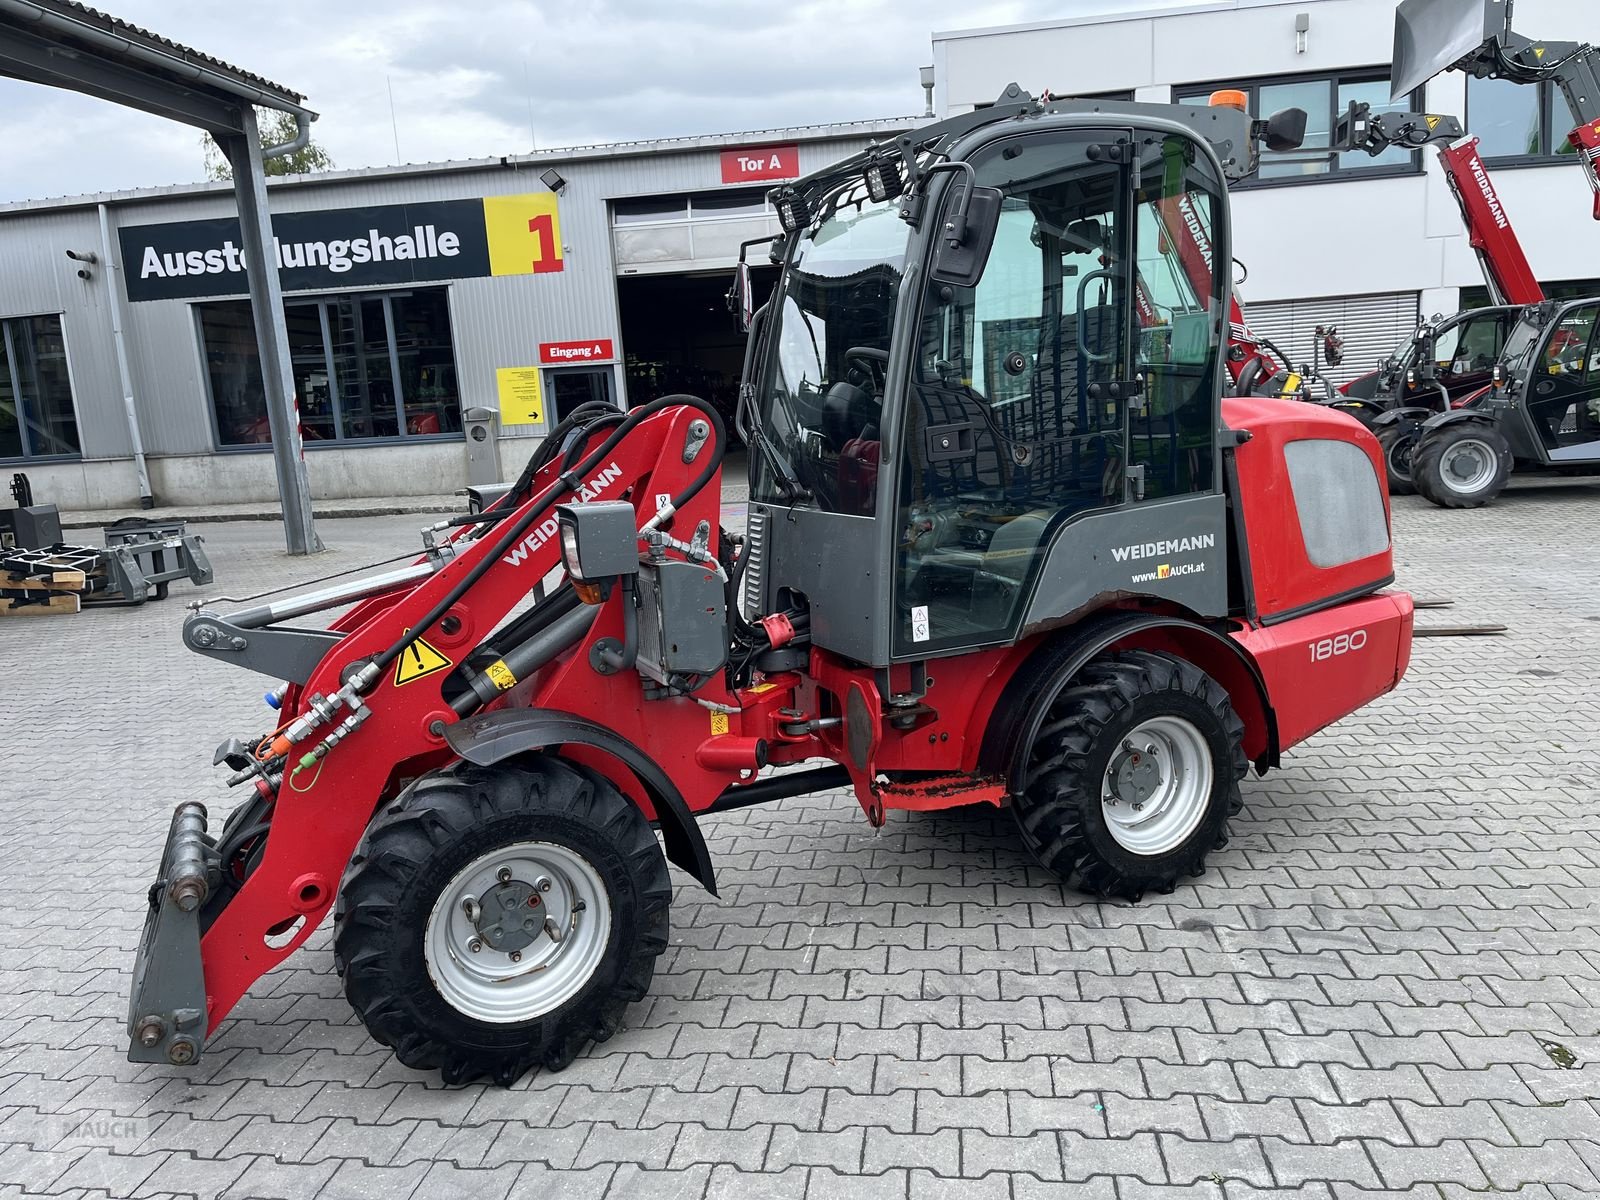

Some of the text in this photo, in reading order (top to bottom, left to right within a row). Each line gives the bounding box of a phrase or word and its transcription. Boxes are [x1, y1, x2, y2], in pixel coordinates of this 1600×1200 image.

[737, 154, 782, 172] Tor A
[1469, 156, 1508, 230] WEIDEMANN
[140, 214, 564, 279] Ausstlungshalle 1
[1178, 196, 1213, 275] WEIDEMA
[549, 344, 602, 358] Eingang A
[502, 461, 623, 567] WEIDANN
[1111, 533, 1215, 562] WEIDEMANN
[1131, 562, 1205, 584] www.MAUCH.at
[1308, 629, 1367, 663] 1880
